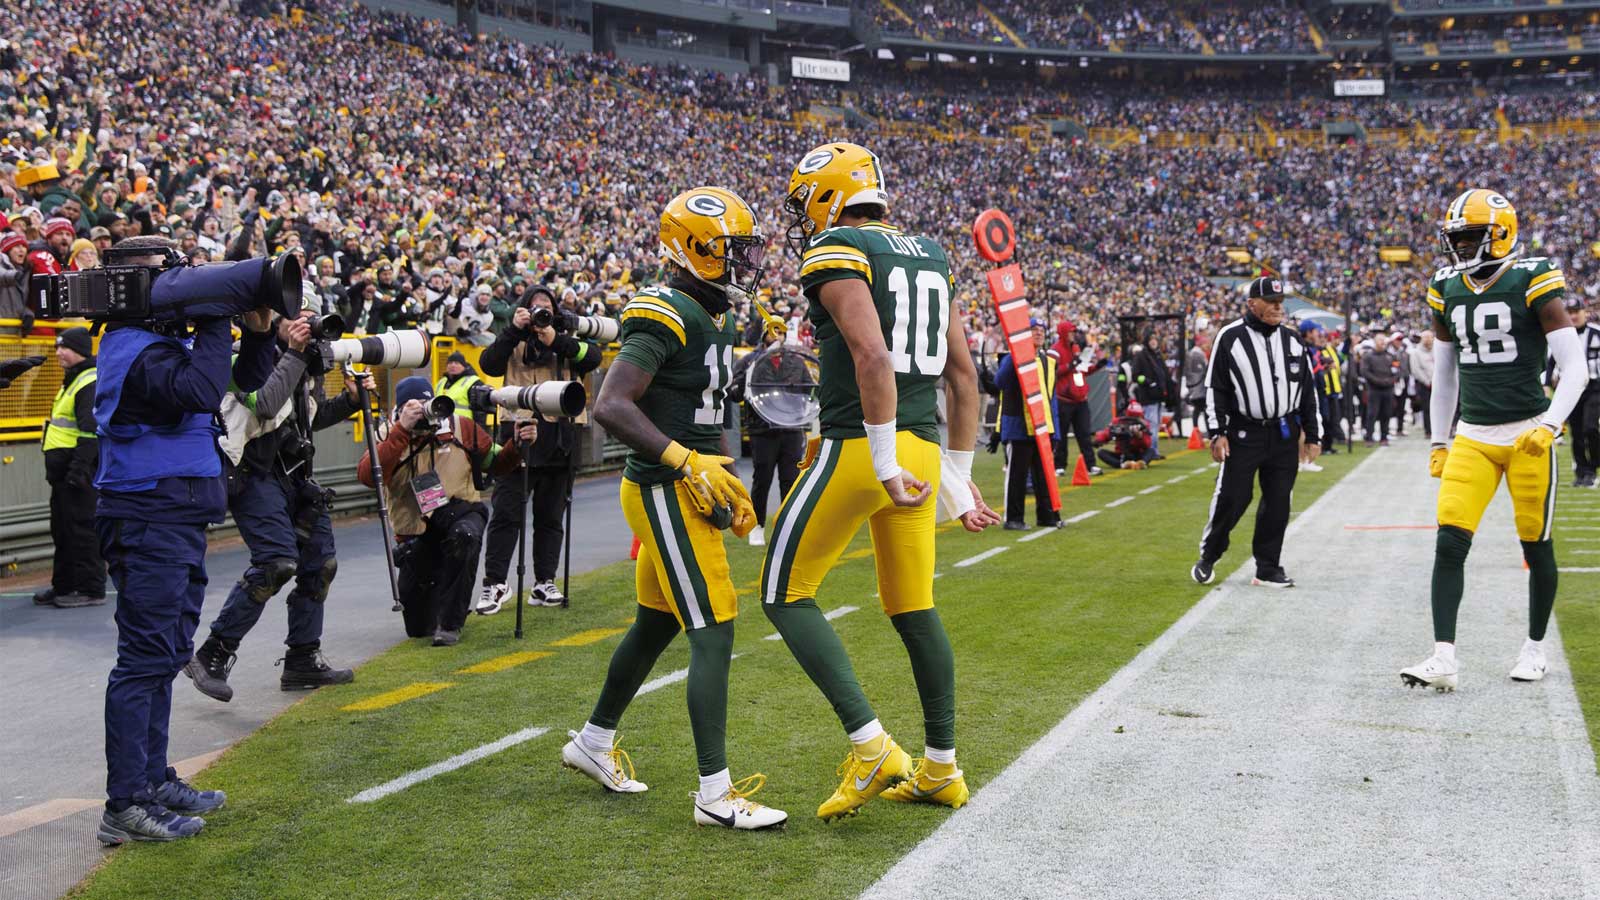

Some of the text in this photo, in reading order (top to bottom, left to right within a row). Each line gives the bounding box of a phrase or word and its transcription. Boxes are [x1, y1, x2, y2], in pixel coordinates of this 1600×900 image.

[685, 194, 727, 217] G
[881, 232, 931, 258] LOVE
[887, 266, 950, 376] 10
[1450, 301, 1519, 364] 18
[693, 343, 734, 425] 11
